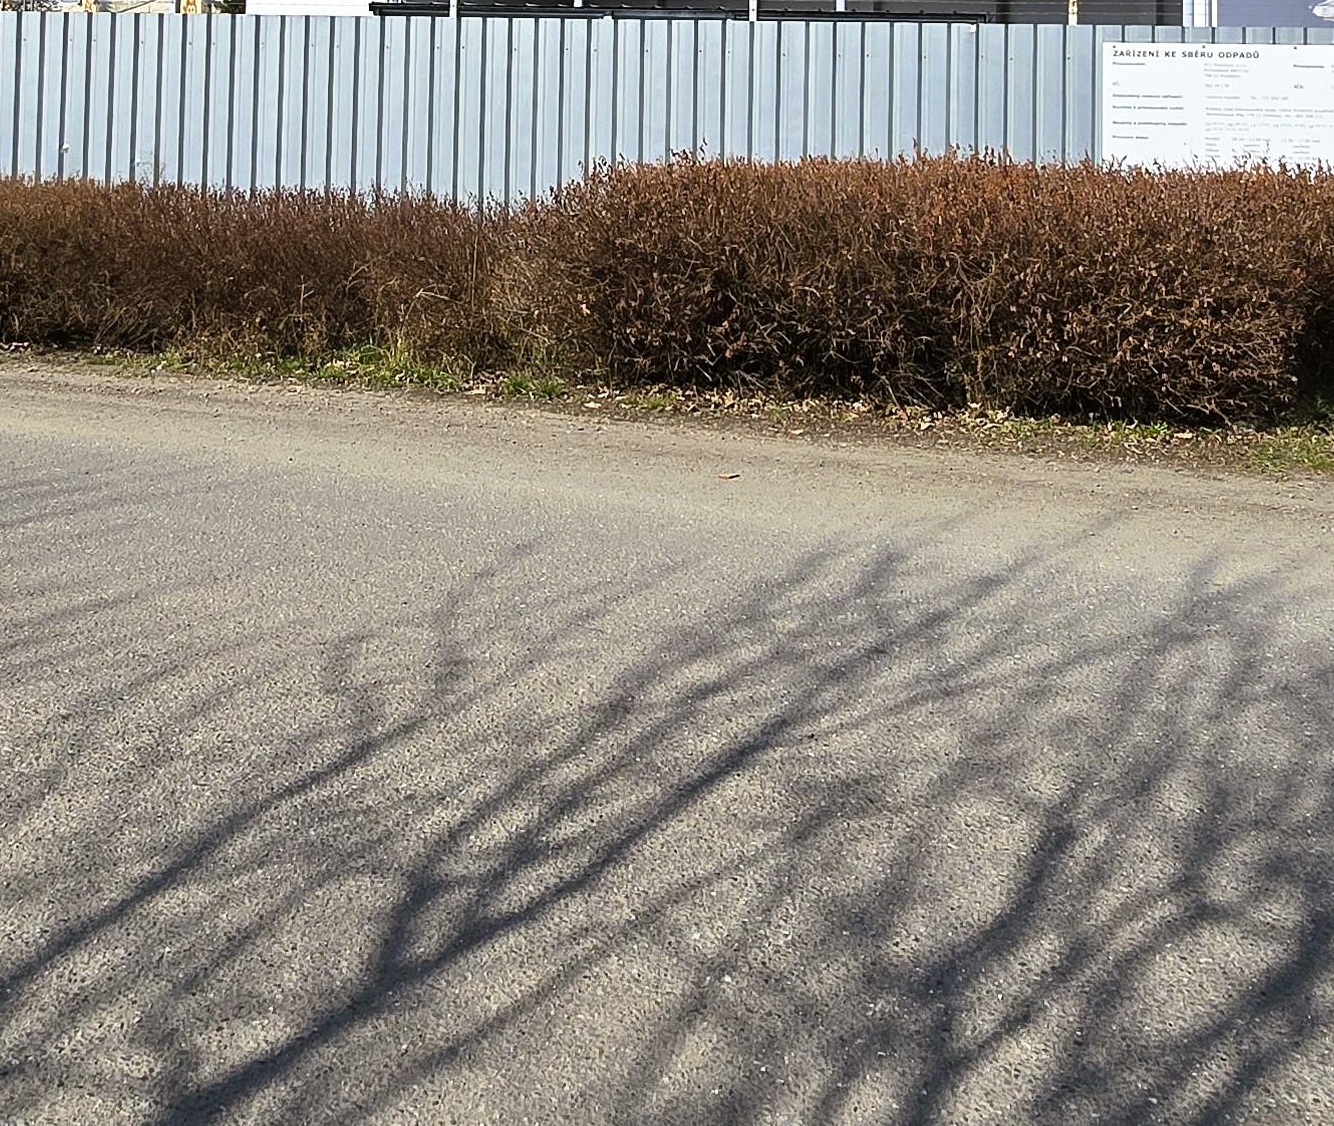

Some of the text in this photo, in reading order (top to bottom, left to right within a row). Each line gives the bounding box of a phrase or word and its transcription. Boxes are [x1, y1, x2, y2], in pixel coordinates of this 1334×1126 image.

[1112, 49, 1260, 59] ZAŘÍZENÍ KE SBĚRU ODPADŮ
